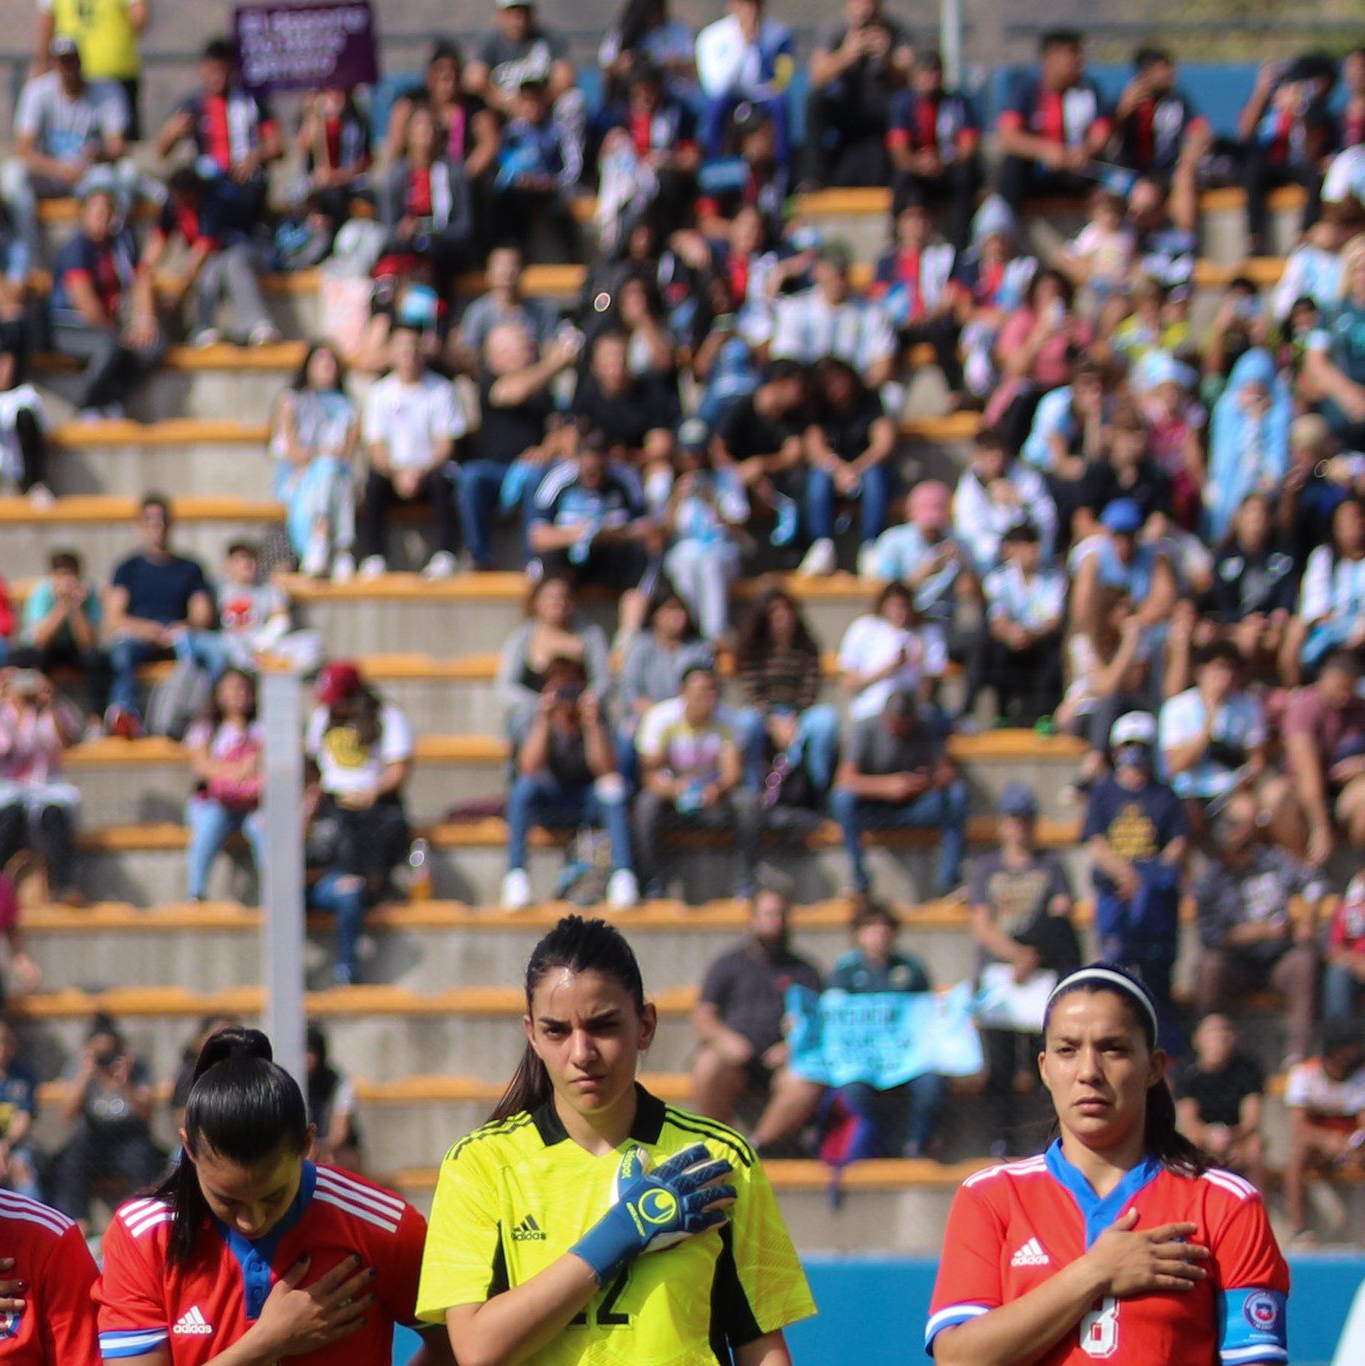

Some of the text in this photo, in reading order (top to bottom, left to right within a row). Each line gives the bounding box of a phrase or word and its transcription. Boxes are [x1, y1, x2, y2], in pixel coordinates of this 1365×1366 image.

[511, 1228, 547, 1242] adidas
[1011, 1253, 1049, 1267] adidas
[566, 1262, 632, 1331] 2
[173, 1322, 213, 1335] adidas
